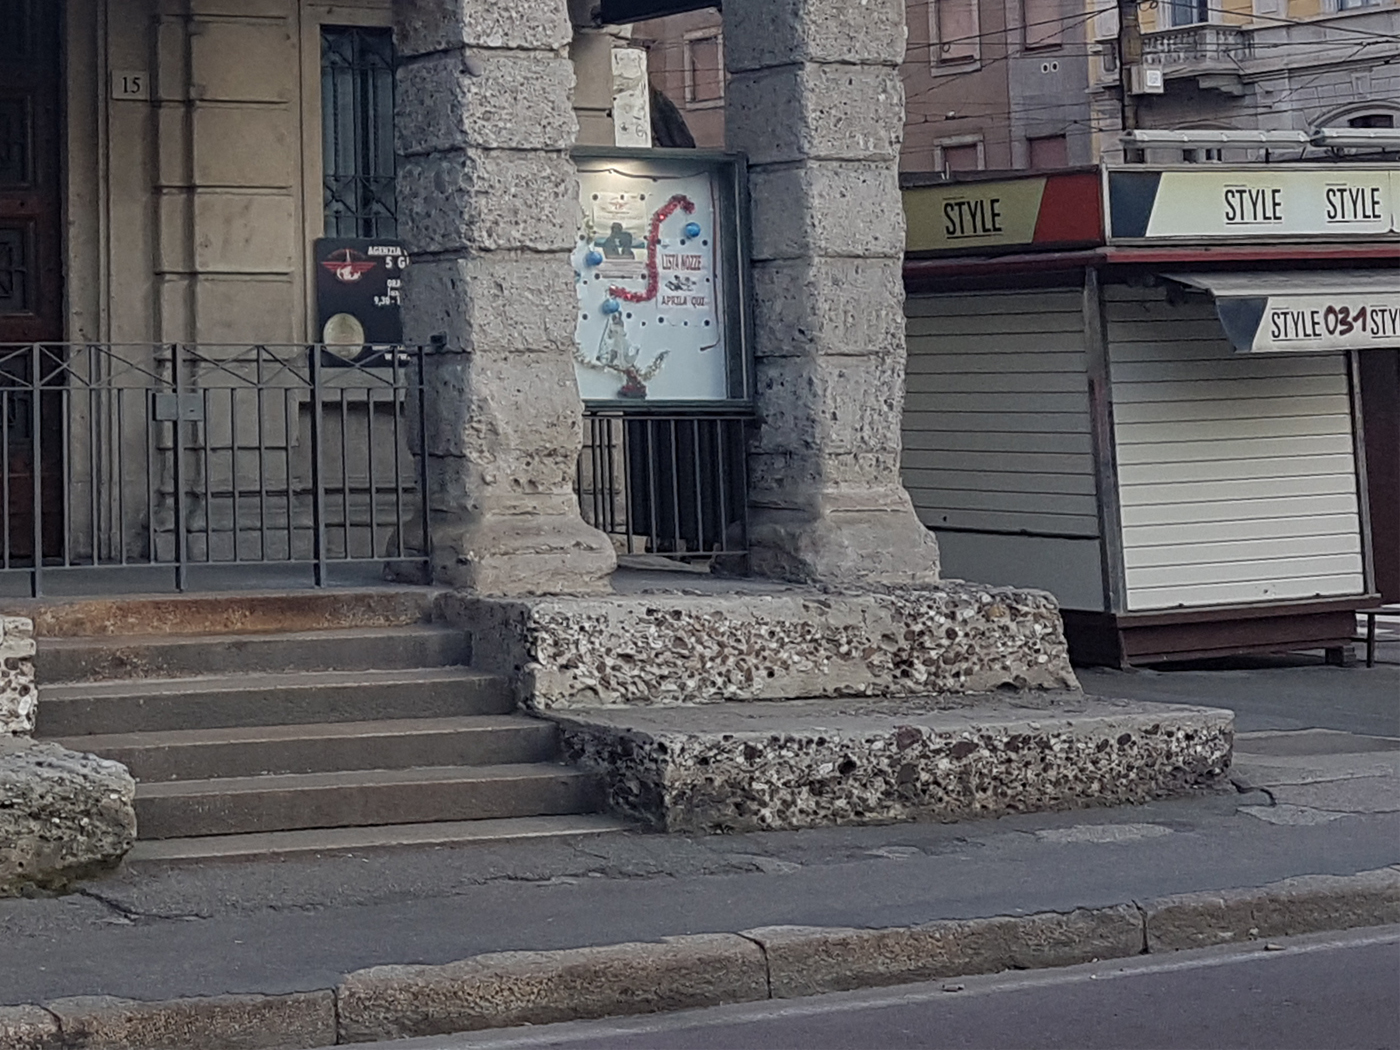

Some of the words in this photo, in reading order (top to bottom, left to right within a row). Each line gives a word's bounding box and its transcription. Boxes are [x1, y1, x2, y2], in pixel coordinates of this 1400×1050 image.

[123, 77, 141, 94] 15
[1224, 189, 1282, 221] STYLE
[1326, 188, 1382, 219] STYLE
[944, 198, 1002, 235] STYLE
[368, 246, 402, 256] AGENZIA
[385, 256, 393, 269] 5
[662, 254, 679, 270] LISTA
[691, 297, 705, 308] QUI
[1271, 311, 1322, 338] STYLE
[1324, 305, 1367, 336] 031
[1370, 309, 1400, 335] STY
